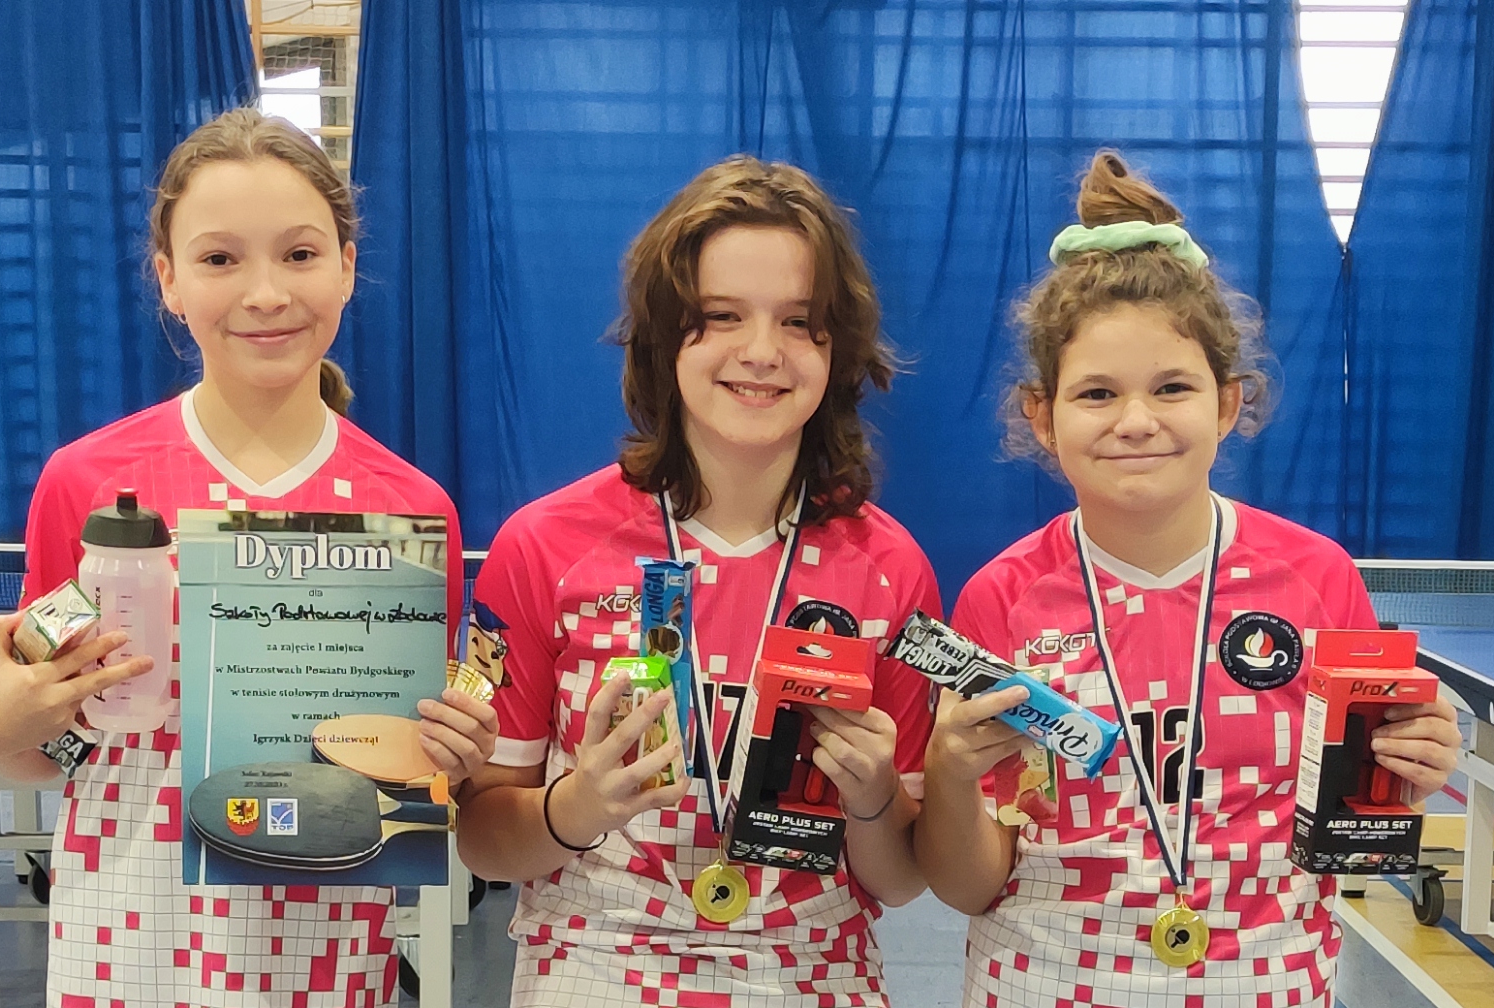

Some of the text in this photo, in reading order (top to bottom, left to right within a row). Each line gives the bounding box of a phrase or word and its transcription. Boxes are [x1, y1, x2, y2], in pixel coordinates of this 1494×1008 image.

[234, 533, 393, 580] Dyplom
[309, 589, 323, 597] dla
[644, 572, 665, 624] LONGA
[280, 642, 315, 654] zajęcie
[318, 643, 322, 651] I
[325, 642, 364, 654] miejsca
[894, 637, 953, 675] LONGA
[934, 638, 967, 662] ZEBRA
[226, 664, 302, 674] Mistrzostwach
[305, 665, 347, 675] Powiatu
[349, 665, 416, 678] Bydgoskiego
[230, 688, 400, 701] w tenisie stołowym drużynowym
[781, 680, 832, 701] ProX
[1350, 681, 1399, 697] ProX
[302, 711, 341, 721] ramach
[253, 733, 379, 746] Igrzysk Dzieci dziewcząt
[1130, 707, 1205, 805] 12
[749, 811, 836, 831] AERO PLUS SET
[1326, 820, 1413, 829] AERO PLUS SET
